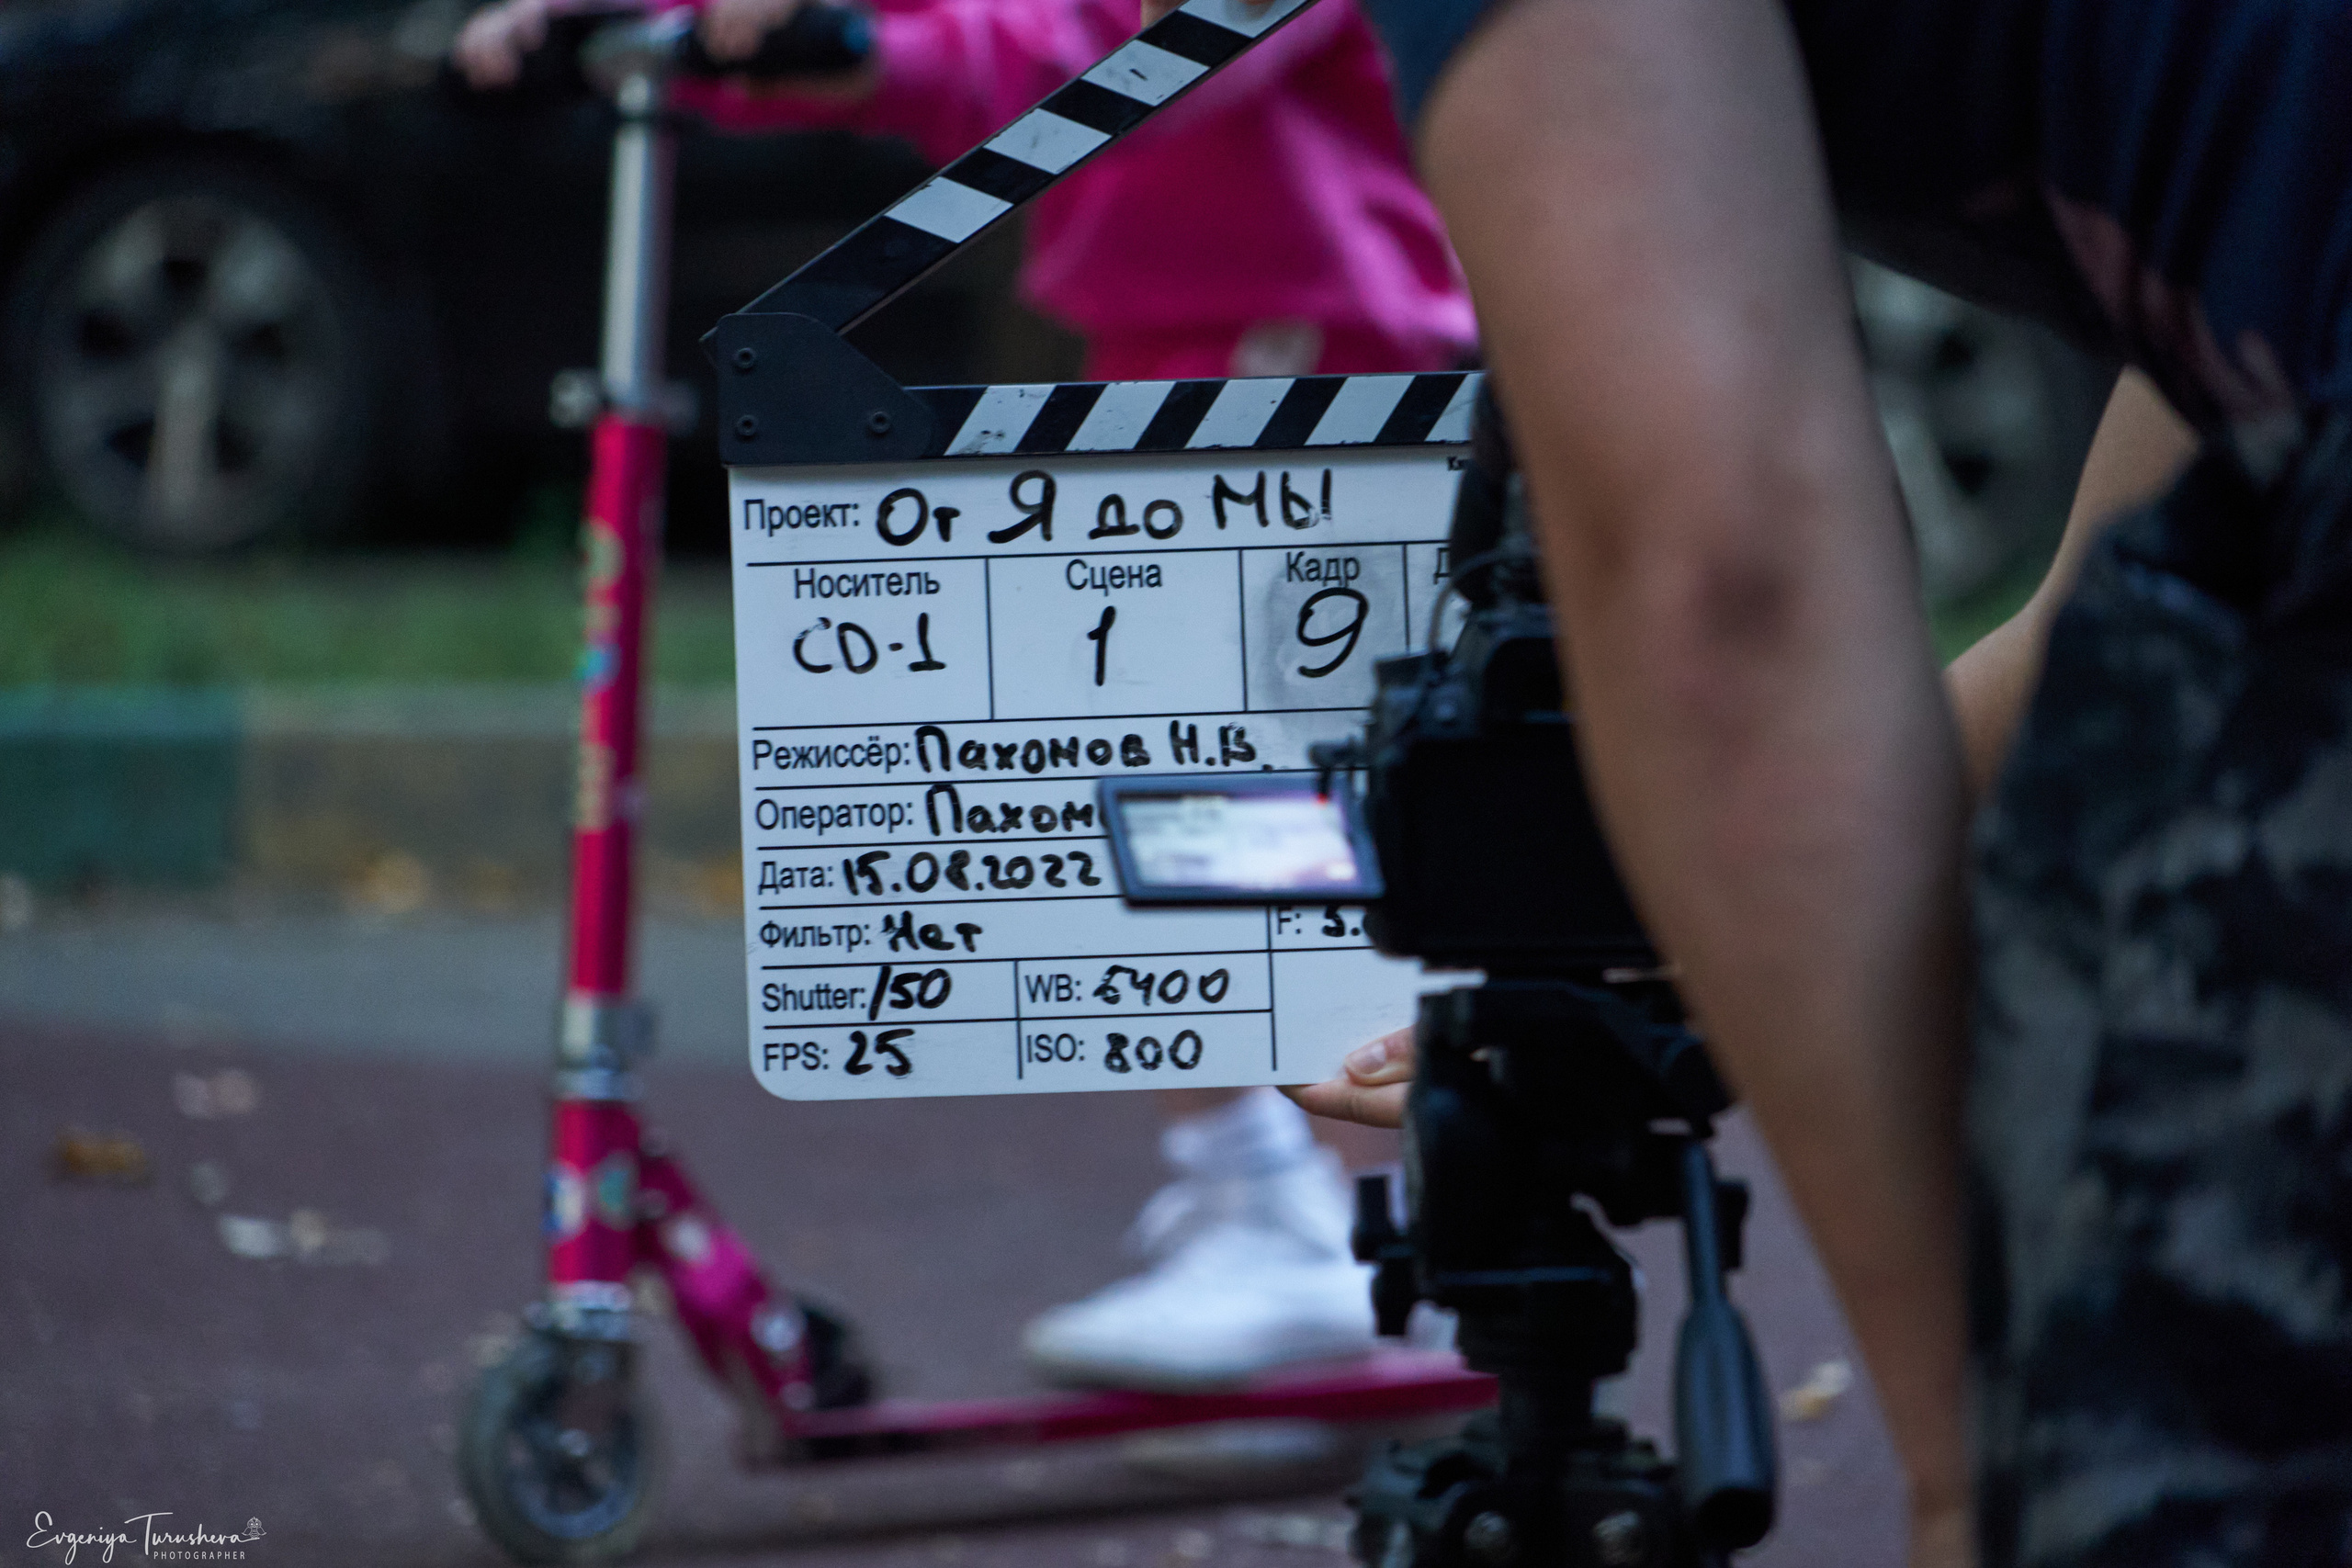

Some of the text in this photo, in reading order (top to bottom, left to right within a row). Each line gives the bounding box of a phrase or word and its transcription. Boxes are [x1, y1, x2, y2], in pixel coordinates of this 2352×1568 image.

[743, 499, 859, 537] Проект:
[876, 488, 960, 546] От
[988, 469, 1056, 544] Я
[794, 568, 941, 599] Носитель
[1066, 558, 1162, 596] Сцена
[1286, 552, 1361, 587] Кадр
[1088, 605, 1116, 686] 1
[1297, 586, 1369, 678] 9
[752, 736, 910, 773] Режиссёр:
[915, 725, 1151, 773] Пахомов
[756, 798, 913, 837] Оператор:
[759, 850, 1102, 897] Дата: 15.08.2022
[759, 910, 984, 953] Фильтр: Нет
[762, 983, 866, 1012] Shutter:
[1024, 974, 1081, 1003] WB:
[763, 1028, 914, 1076] FPS: 25
[1026, 1029, 1203, 1074] ISO: 800
